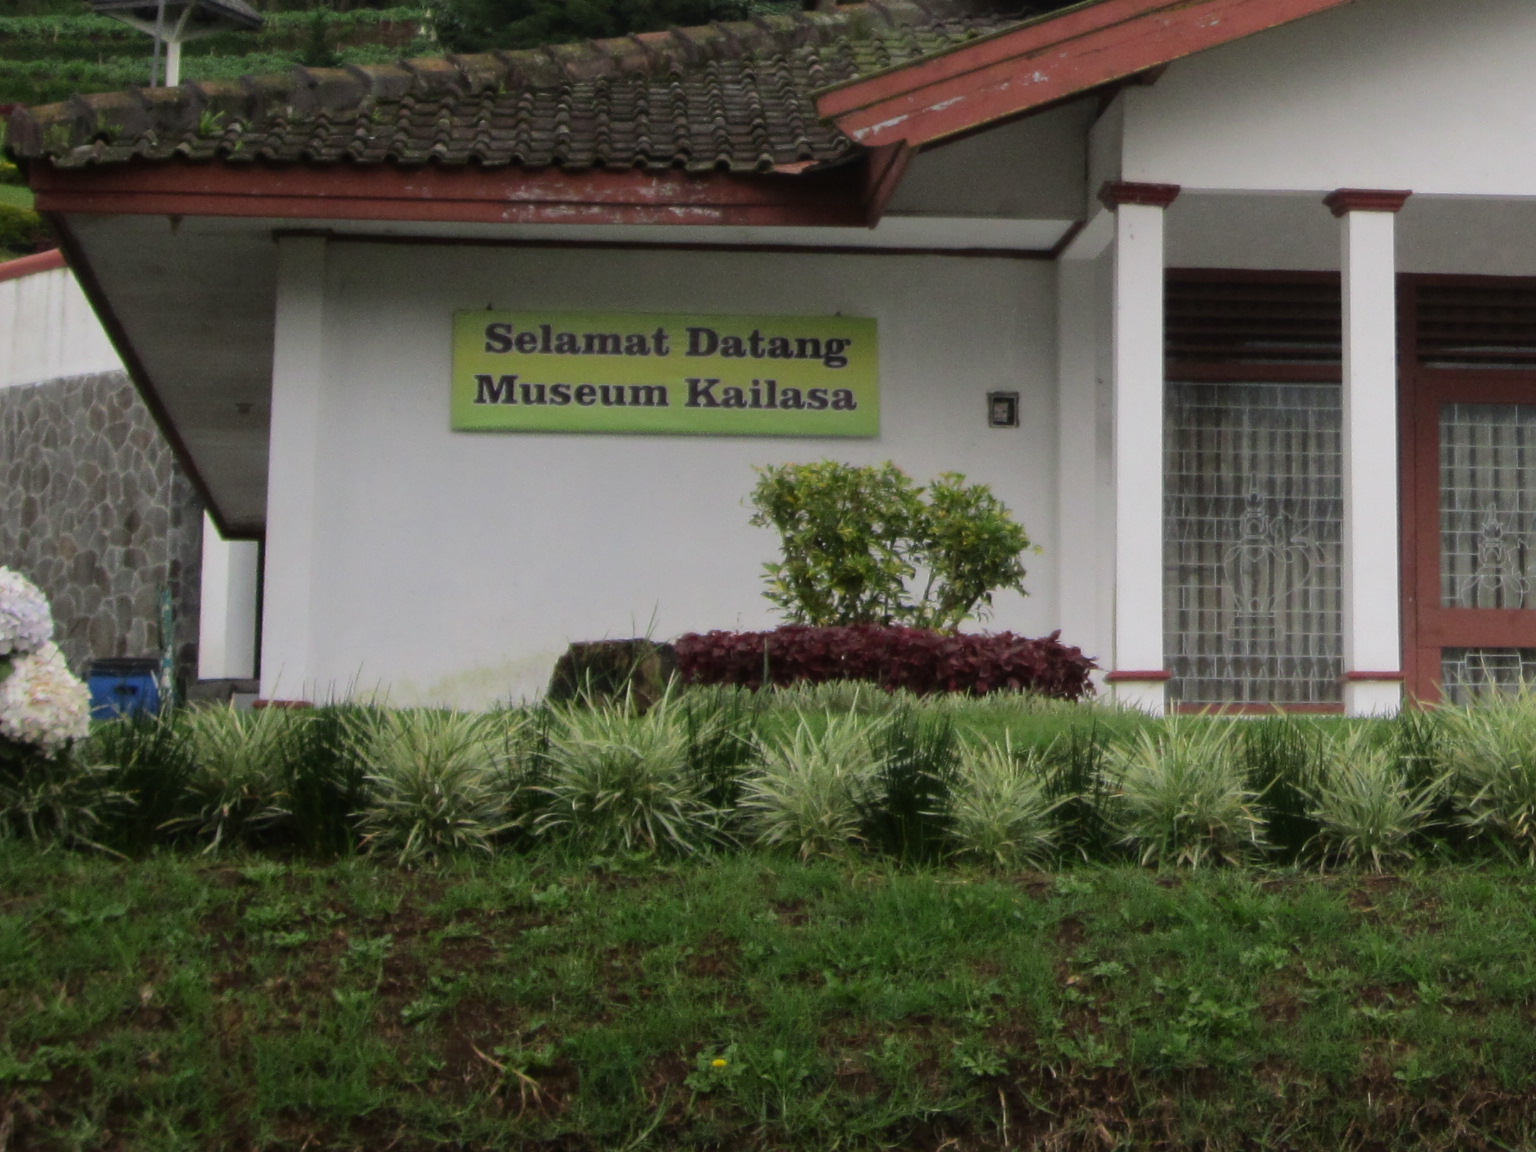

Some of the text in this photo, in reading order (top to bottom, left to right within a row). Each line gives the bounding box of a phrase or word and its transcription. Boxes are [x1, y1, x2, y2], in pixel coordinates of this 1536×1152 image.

[484, 322, 852, 368] Selamat Datang
[473, 374, 858, 411] Museum Kailasa
